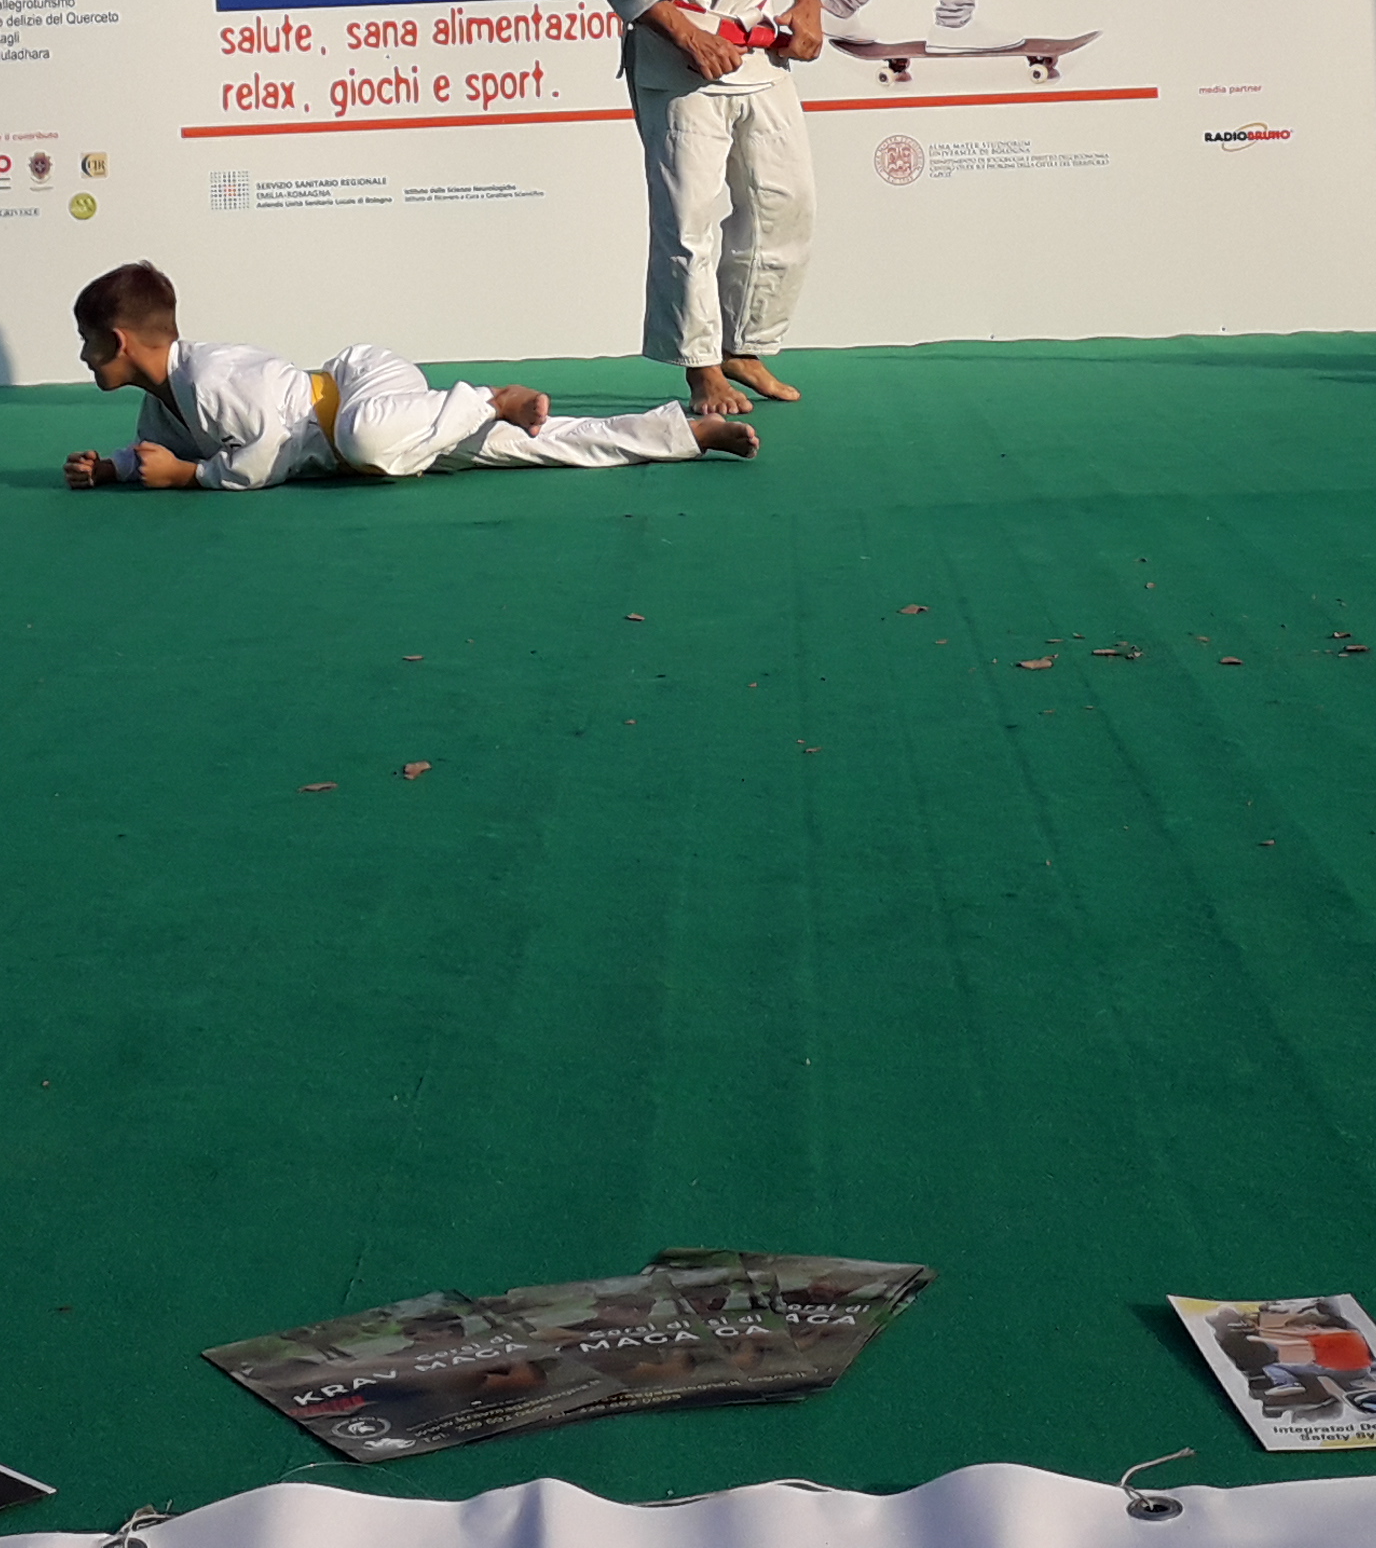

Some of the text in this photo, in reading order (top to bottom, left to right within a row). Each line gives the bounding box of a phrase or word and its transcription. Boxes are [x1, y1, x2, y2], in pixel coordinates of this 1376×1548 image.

[6, 14, 42, 27] delizie
[46, 13, 62, 25] del
[66, 11, 119, 25] Querceto
[346, 18, 418, 49] sana
[432, 2, 624, 46] alimentazion
[330, 66, 419, 117] giochi
[433, 73, 450, 103] e
[579, 1329, 701, 1352] MAGA
[293, 1370, 397, 1406] KRAV
[1273, 1424, 1355, 1437] Integrated
